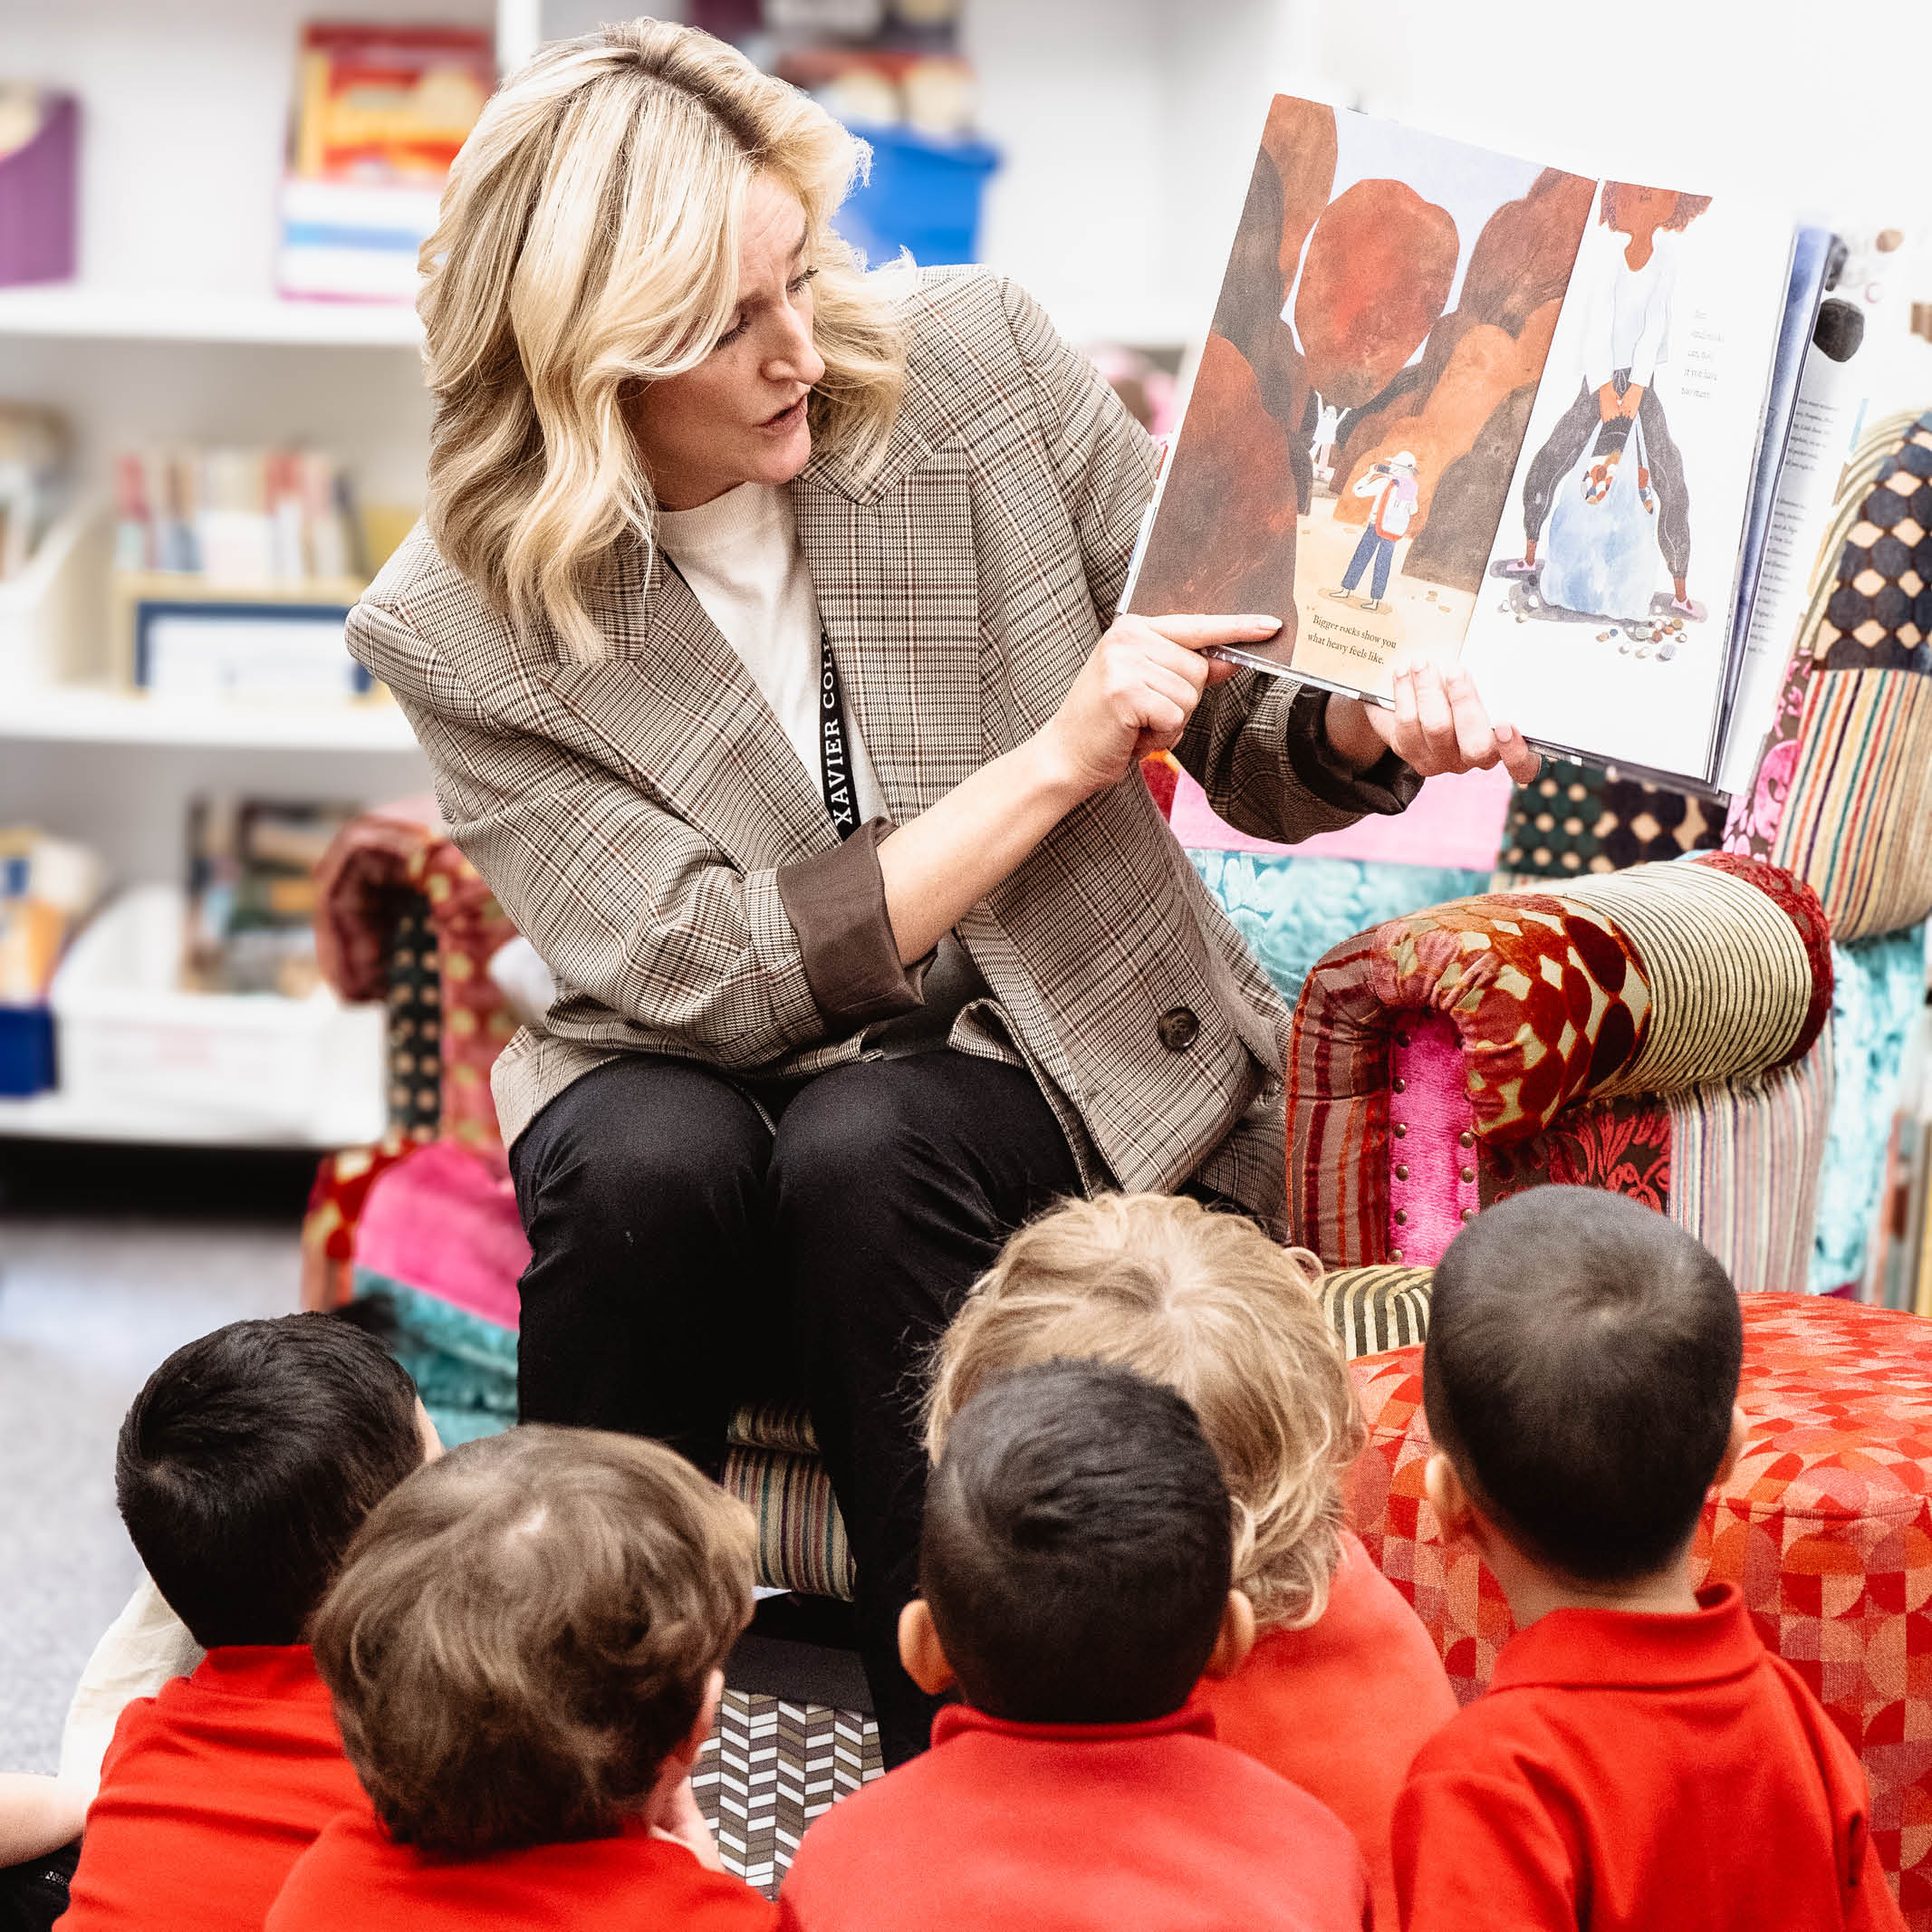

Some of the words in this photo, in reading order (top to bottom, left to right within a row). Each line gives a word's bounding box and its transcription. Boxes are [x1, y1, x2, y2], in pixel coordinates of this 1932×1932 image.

[1307, 632, 1326, 646] what
[1327, 638, 1349, 655] heavy
[1349, 645, 1368, 659] feels
[1368, 651, 1385, 665] like.
[1312, 614, 1339, 630] Bigger
[1340, 625, 1360, 637] rocks
[1361, 630, 1381, 643] show
[1381, 639, 1397, 649] you
[824, 718, 853, 826] XAVIER
